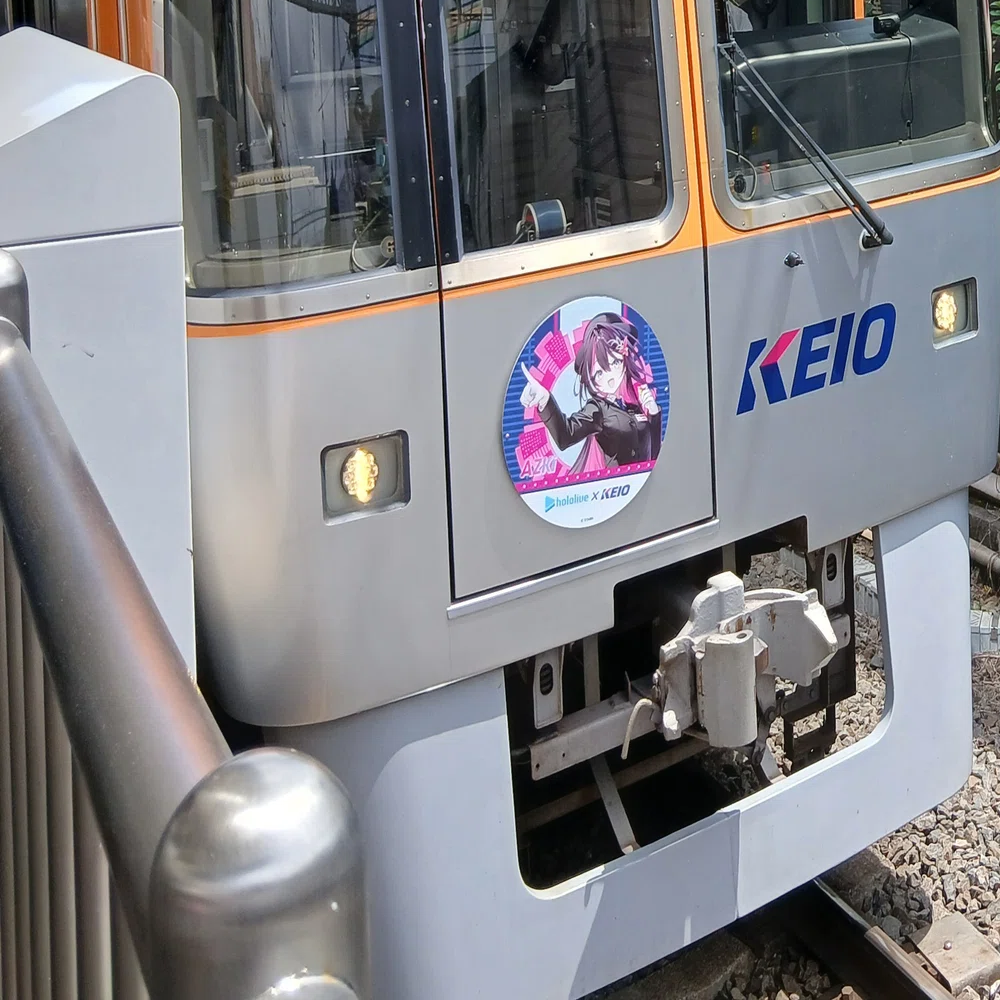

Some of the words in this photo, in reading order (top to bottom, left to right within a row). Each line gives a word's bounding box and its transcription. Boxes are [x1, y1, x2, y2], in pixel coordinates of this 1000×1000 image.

[736, 302, 897, 416] KEIO
[556, 495, 589, 508] hololive
[600, 484, 631, 500] KEIO
